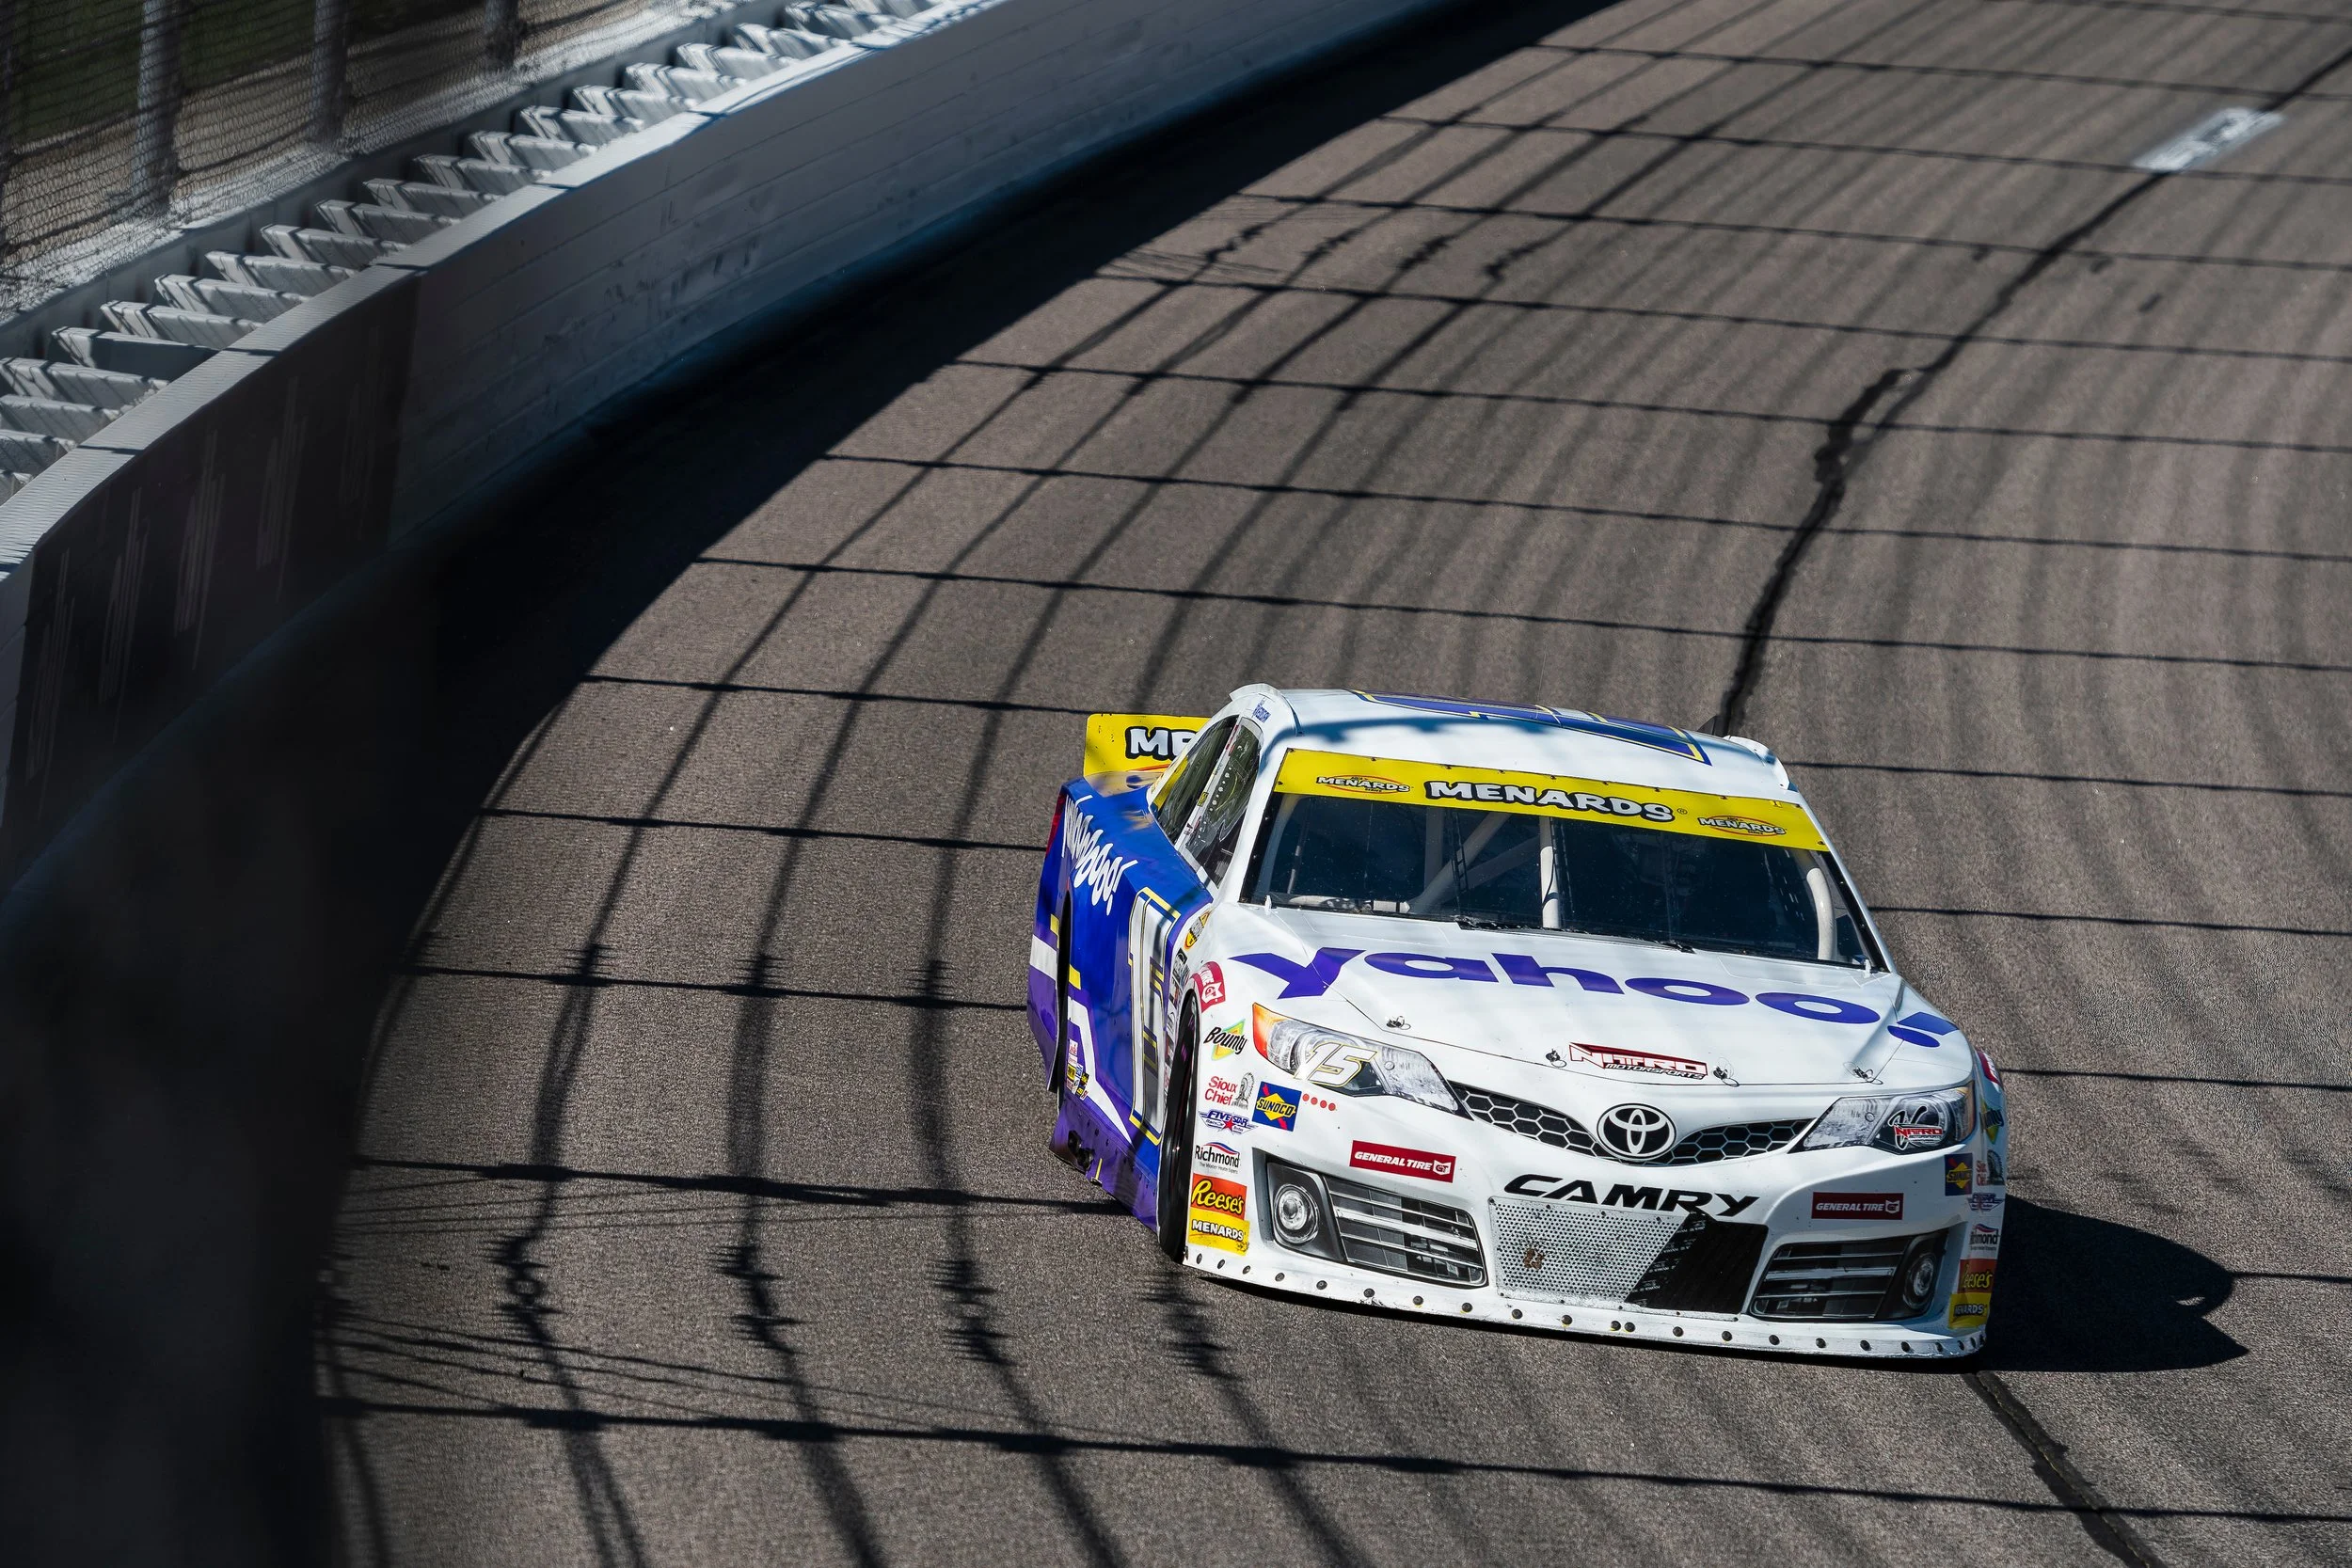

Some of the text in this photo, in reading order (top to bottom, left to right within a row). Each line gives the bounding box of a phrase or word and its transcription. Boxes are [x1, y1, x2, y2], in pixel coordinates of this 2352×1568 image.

[1316, 776, 1410, 792] MENARDS
[1424, 781, 1675, 822] MENARDS
[1697, 817, 1787, 835] MENARDS
[1203, 1026, 1248, 1054] Bounty
[1294, 1041, 1378, 1087] 15
[1568, 1042, 1708, 1076] NITRO
[1604, 1063, 1707, 1080] MOTORSPORTS
[1208, 1076, 1238, 1092] Sioux
[1204, 1088, 1233, 1106] Chief
[1207, 1109, 1232, 1122] FIVE
[1256, 1099, 1295, 1117] SUNOCO
[1195, 1145, 1241, 1168] Richmond
[1355, 1150, 1433, 1171] GENERAL TIRE
[1504, 1174, 1760, 1216] CAMRY
[1816, 1202, 1861, 1212] GENERAL
[1862, 1202, 1883, 1212] TIRE
[1192, 1219, 1245, 1241] MENARDS
